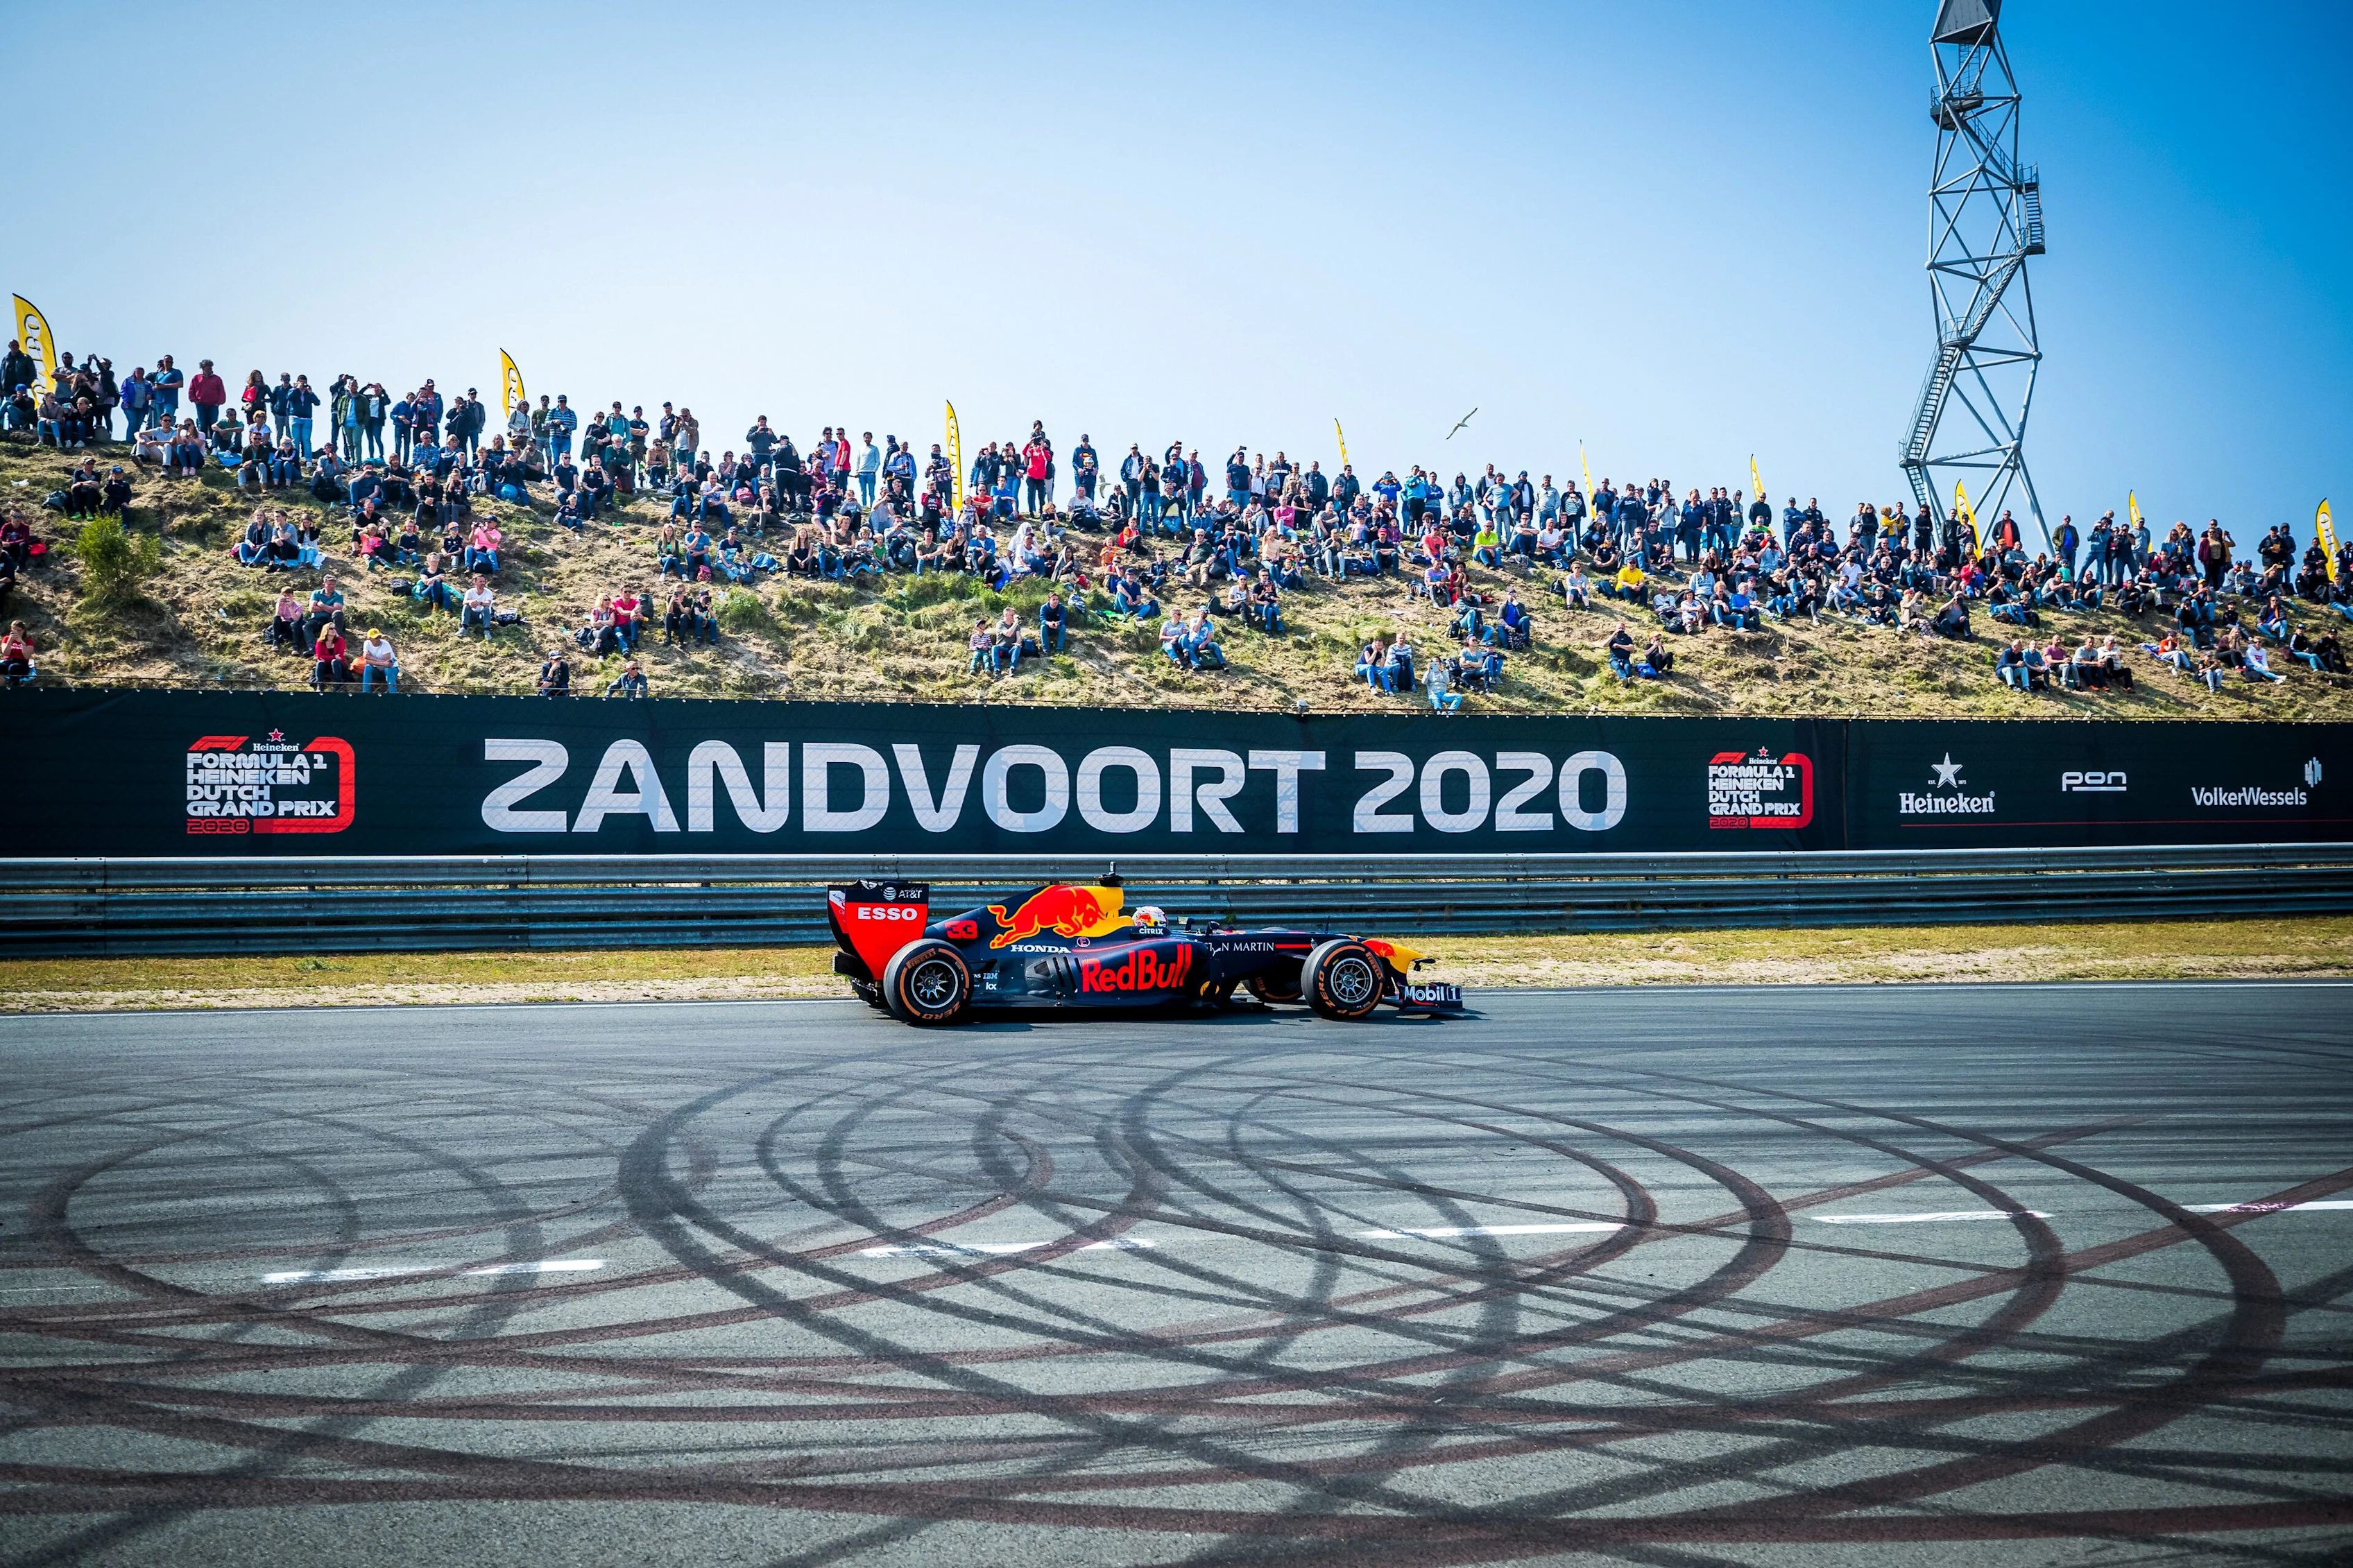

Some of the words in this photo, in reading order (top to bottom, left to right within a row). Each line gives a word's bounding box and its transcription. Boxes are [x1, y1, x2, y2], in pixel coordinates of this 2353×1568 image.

[253, 743, 300, 752] Heineken
[187, 752, 310, 769] FORMULA
[314, 754, 327, 769] 1
[187, 769, 310, 784] HEINEKEN
[1709, 766, 1784, 778] FORMULA
[1786, 766, 1795, 778] 1
[481, 739, 1326, 833] ZANDVOORT
[1353, 750, 1627, 833] 2020
[1709, 778, 1784, 791] HEINEKEN
[2062, 771, 2127, 791] pon
[187, 785, 270, 800] DUTCH
[1709, 791, 1760, 802] DUTCH
[2191, 787, 2307, 806] VolkerWessels
[187, 801, 275, 816] GRAND
[278, 801, 336, 816] PRIX
[1709, 803, 1763, 815] GRAND
[1765, 803, 1801, 815] PRIX
[1899, 792, 1995, 813] Heineken
[187, 818, 250, 834] 2020
[1709, 816, 1748, 829] 2020
[898, 890, 922, 899] AT&T
[858, 907, 918, 920] ESSO
[945, 920, 978, 939] 33
[1011, 944, 1072, 954] HONDA
[1233, 942, 1274, 951] MARTIN
[1318, 970, 1336, 1008] ZERO
[1404, 986, 1445, 1001] Mobil
[922, 1001, 961, 1019] ZERO
